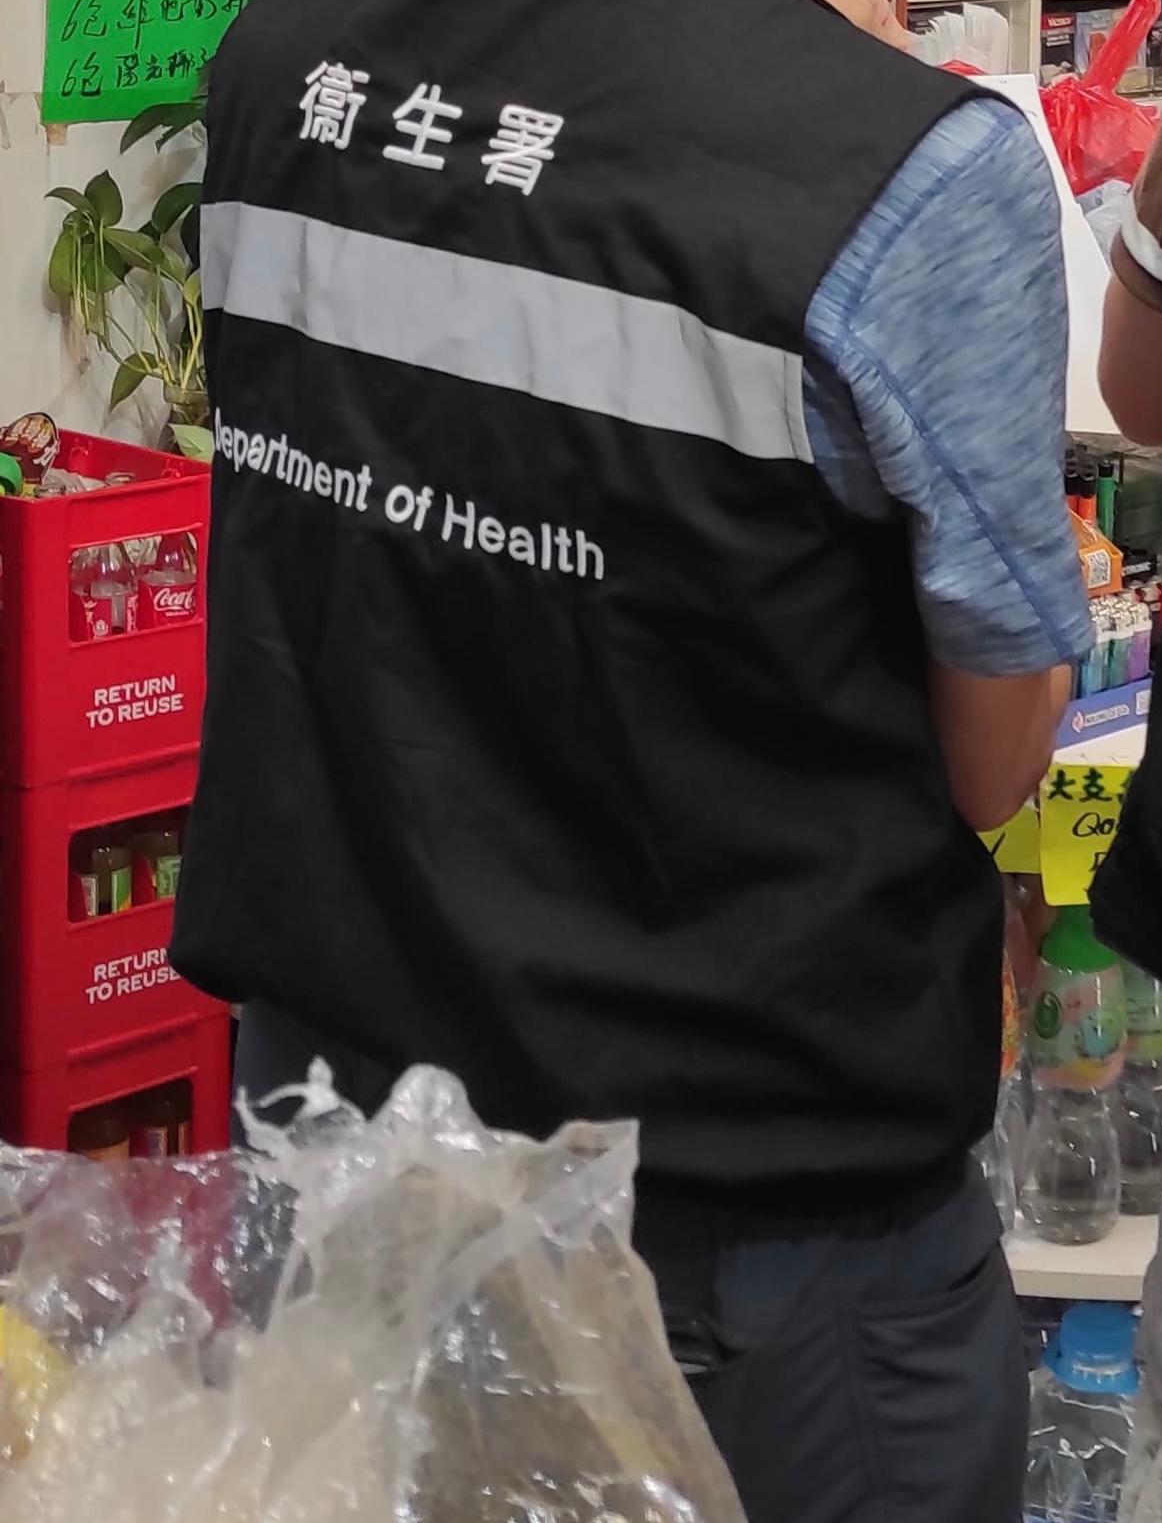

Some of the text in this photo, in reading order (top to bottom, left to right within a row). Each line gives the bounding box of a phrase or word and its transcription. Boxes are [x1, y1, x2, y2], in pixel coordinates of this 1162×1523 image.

[384, 483, 434, 532] of
[440, 492, 605, 581] Health
[93, 674, 176, 708] RETURN
[85, 693, 184, 729] TO REUSE
[85, 981, 114, 1005] TO
